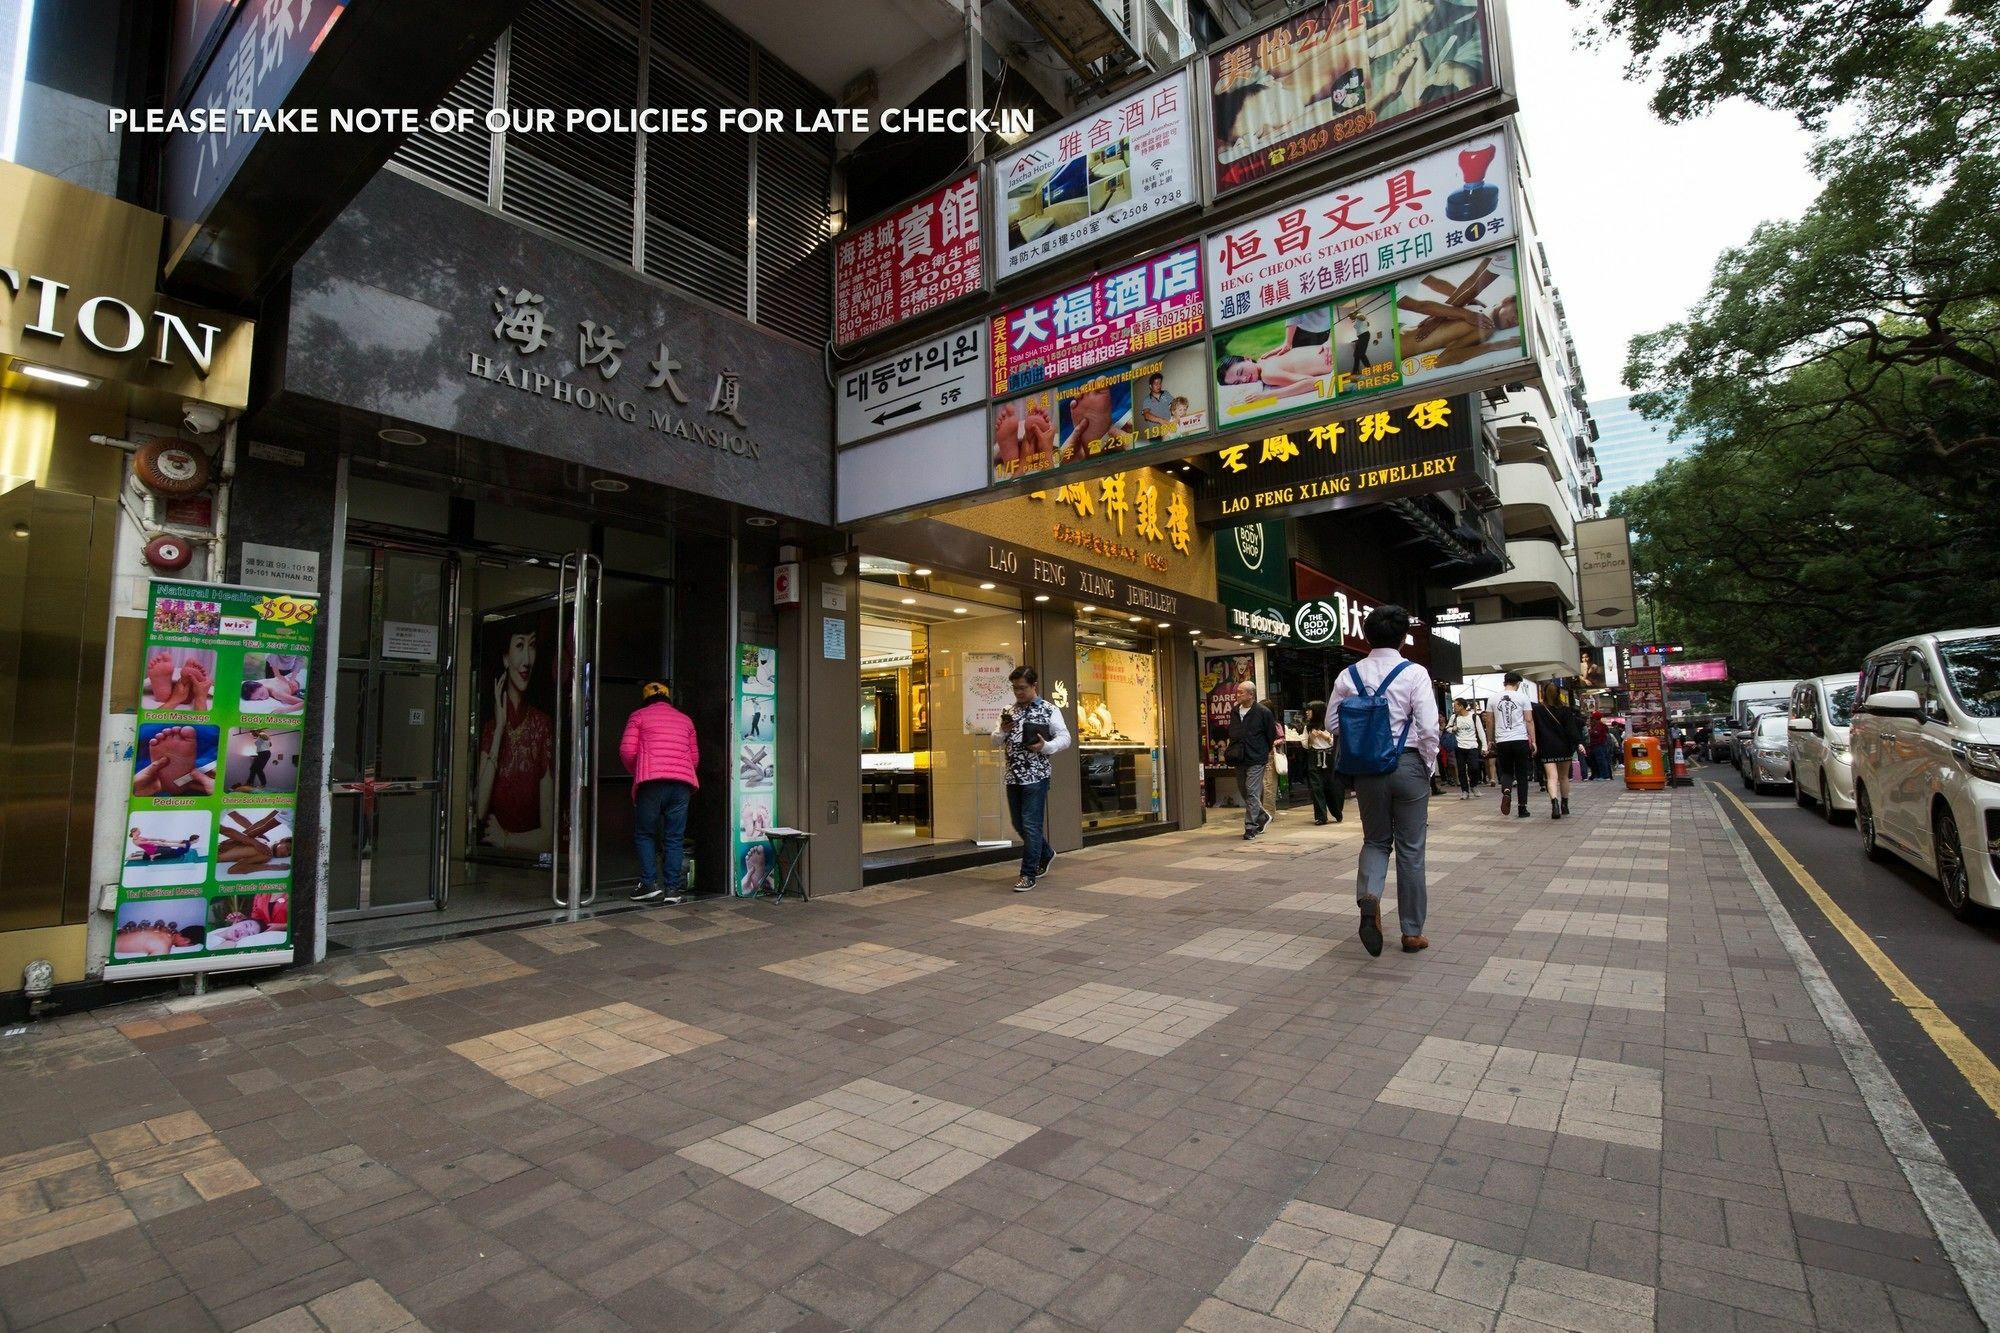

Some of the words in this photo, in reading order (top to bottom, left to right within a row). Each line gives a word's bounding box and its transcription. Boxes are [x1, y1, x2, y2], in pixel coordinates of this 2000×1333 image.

[1057, 85, 1179, 163] 雅舍酒店
[1287, 129, 1329, 160] 2369
[1333, 110, 1377, 142] 8289
[1008, 172, 1032, 188] Jascha
[1033, 157, 1055, 173] Hotel
[1141, 174, 1158, 186] FREE
[1159, 168, 1174, 179] WIFI
[1122, 203, 1149, 221] 2508
[1154, 189, 1182, 207] 9238
[839, 220, 896, 270] 海港城
[898, 178, 979, 268] 賓館
[1219, 169, 1432, 278] 恒昌文具
[838, 269, 853, 282] Hi
[856, 246, 897, 273] Hotel
[1220, 272, 1254, 293] HENG
[1259, 253, 1312, 279] CHEONG
[1318, 221, 1402, 260] STATIONERY
[1409, 213, 1434, 229] CO.
[900, 265, 981, 309] 8樓809室
[1220, 290, 1251, 321] 過膠
[1300, 252, 1369, 295] 彩色影印
[1377, 231, 1433, 271] 原子印
[912, 279, 982, 318] 60975788
[1011, 248, 1198, 350] 大福酒店
[0, 266, 221, 379] ION
[1009, 354, 1024, 364] TSIM
[1025, 348, 1038, 359] SHA
[1039, 343, 1054, 353] TSUI
[1055, 300, 1184, 350] HOTEL
[1185, 291, 1200, 305] 8/F
[1129, 315, 1203, 353] 特惠自由行
[846, 330, 979, 402] 대동한의원
[1081, 379, 1105, 393] HEALING
[1105, 373, 1120, 387] FOOT
[1313, 372, 1352, 398] 1/F
[1356, 372, 1399, 390] PRESS
[467, 351, 638, 424] HAIPHONG
[649, 408, 761, 460] MANSION
[995, 458, 1020, 478] 1/F
[1022, 460, 1050, 473] PRESS
[1222, 497, 1250, 514] LAO
[1255, 487, 1293, 508] FENG
[1300, 476, 1350, 500] XIANG
[1358, 455, 1458, 489] JEWELLERY
[1240, 528, 1259, 547] BODY
[1242, 543, 1259, 558] SHOP
[1583, 560, 1626, 570] Camphora
[1594, 551, 1612, 560] The
[245, 567, 269, 578] 99-101
[271, 571, 300, 581] NATHAN
[303, 574, 315, 583] RD.
[988, 545, 1018, 574] LAO
[1033, 557, 1066, 587] FENG
[1079, 570, 1115, 599] XIANG
[1126, 584, 1177, 615] JEWELLERY
[156, 584, 209, 599] Natural
[212, 589, 263, 604] Healing
[262, 599, 316, 621] $98
[1232, 608, 1250, 628] THE
[1303, 619, 1330, 630] BODY
[1305, 627, 1329, 637] SHOP
[1212, 693, 1236, 702] DARE
[144, 712, 167, 722] Foot
[168, 713, 210, 723] Massage
[240, 715, 263, 725] Body
[265, 716, 302, 725] Massage
[153, 797, 196, 806] Pedicure
[175, 887, 203, 896] Massage
[258, 882, 288, 891] Massage
